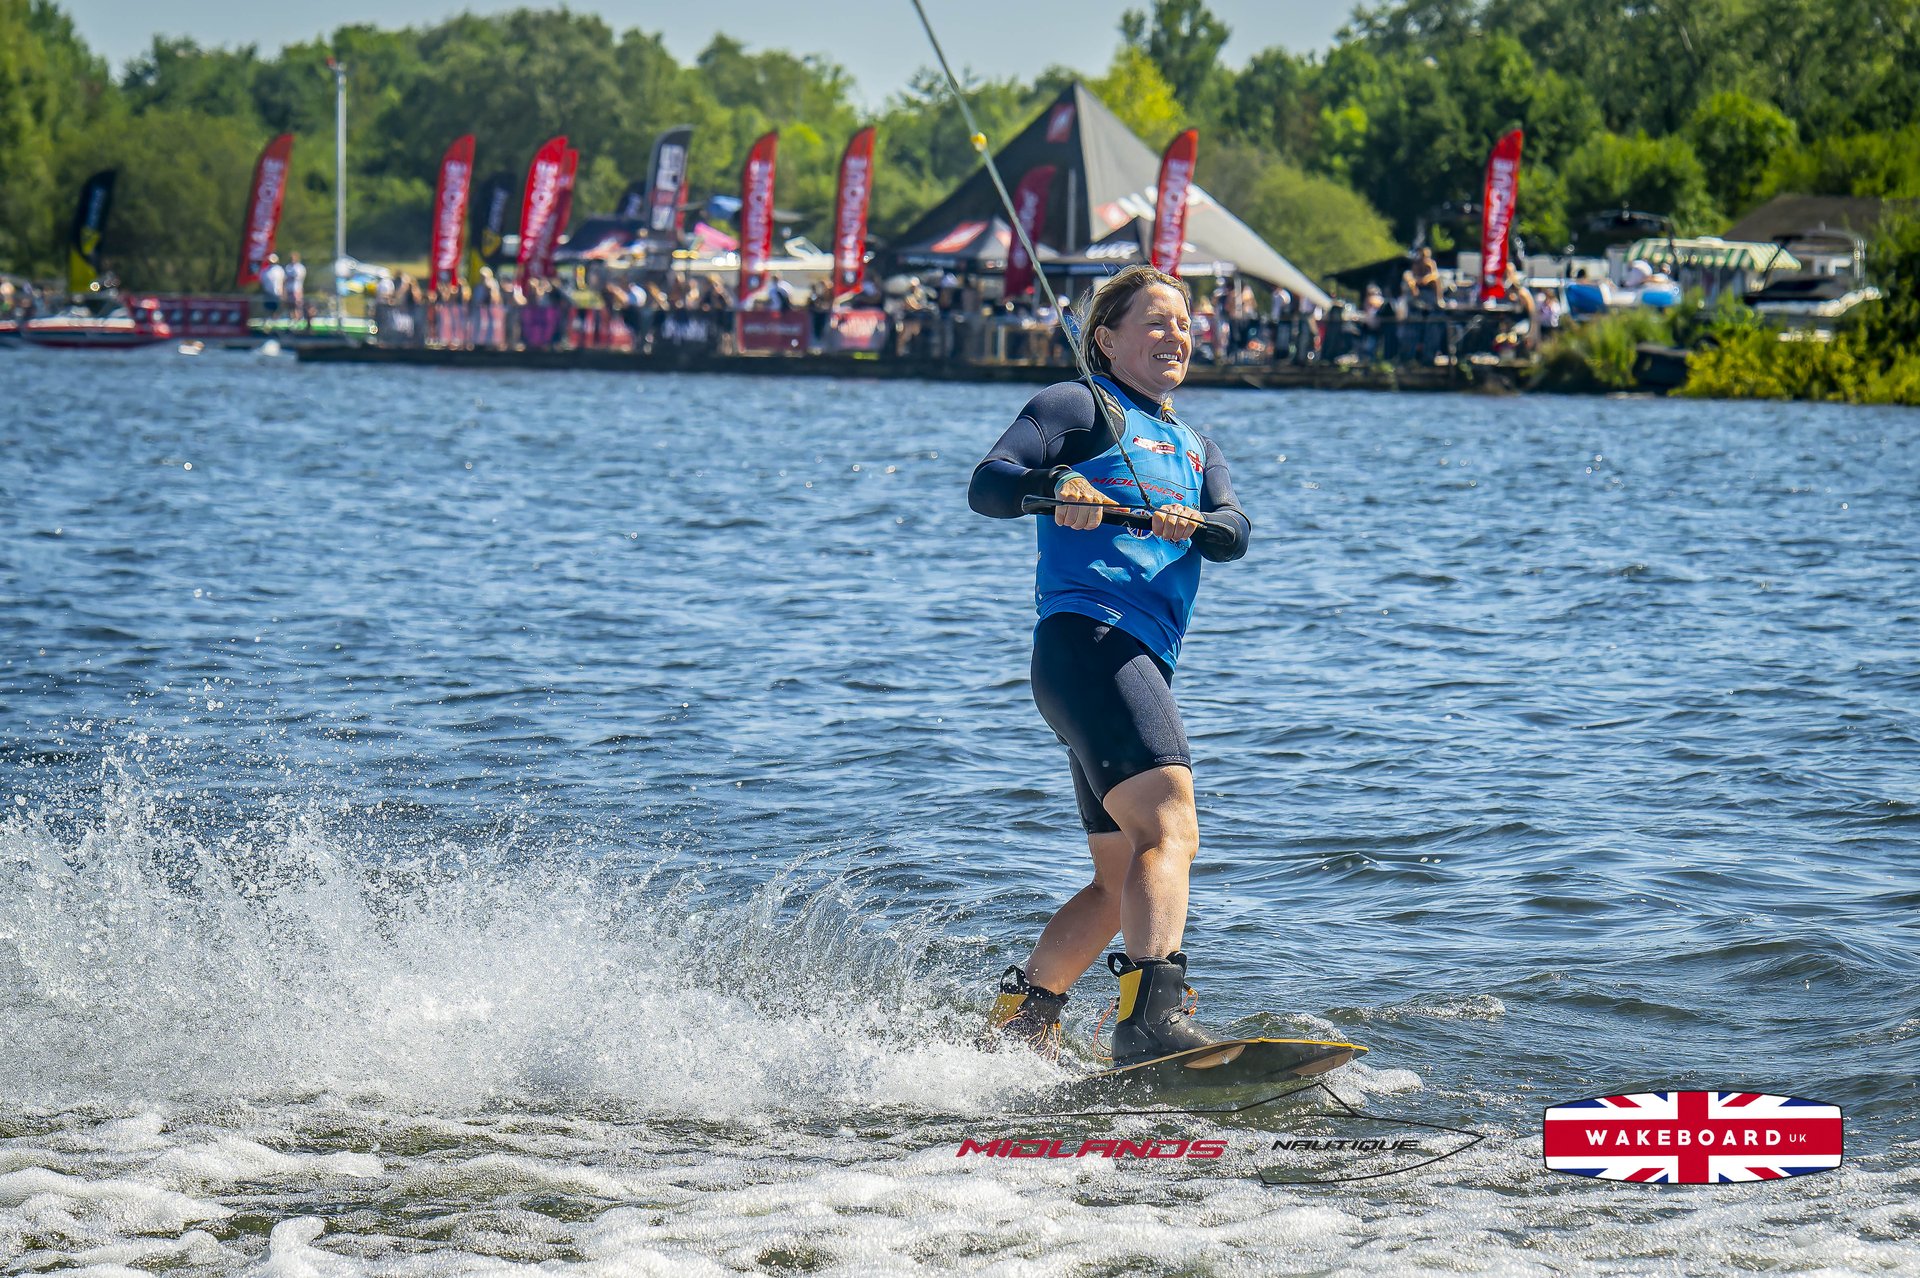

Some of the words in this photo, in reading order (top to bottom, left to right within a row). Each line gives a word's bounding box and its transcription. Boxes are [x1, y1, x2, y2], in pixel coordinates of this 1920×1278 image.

[438, 160, 467, 269] NAUTIQUE
[841, 157, 867, 269] NAUTIQUE
[1484, 158, 1514, 273] NAUTIQUE
[1090, 477, 1185, 501] MIDLANDS
